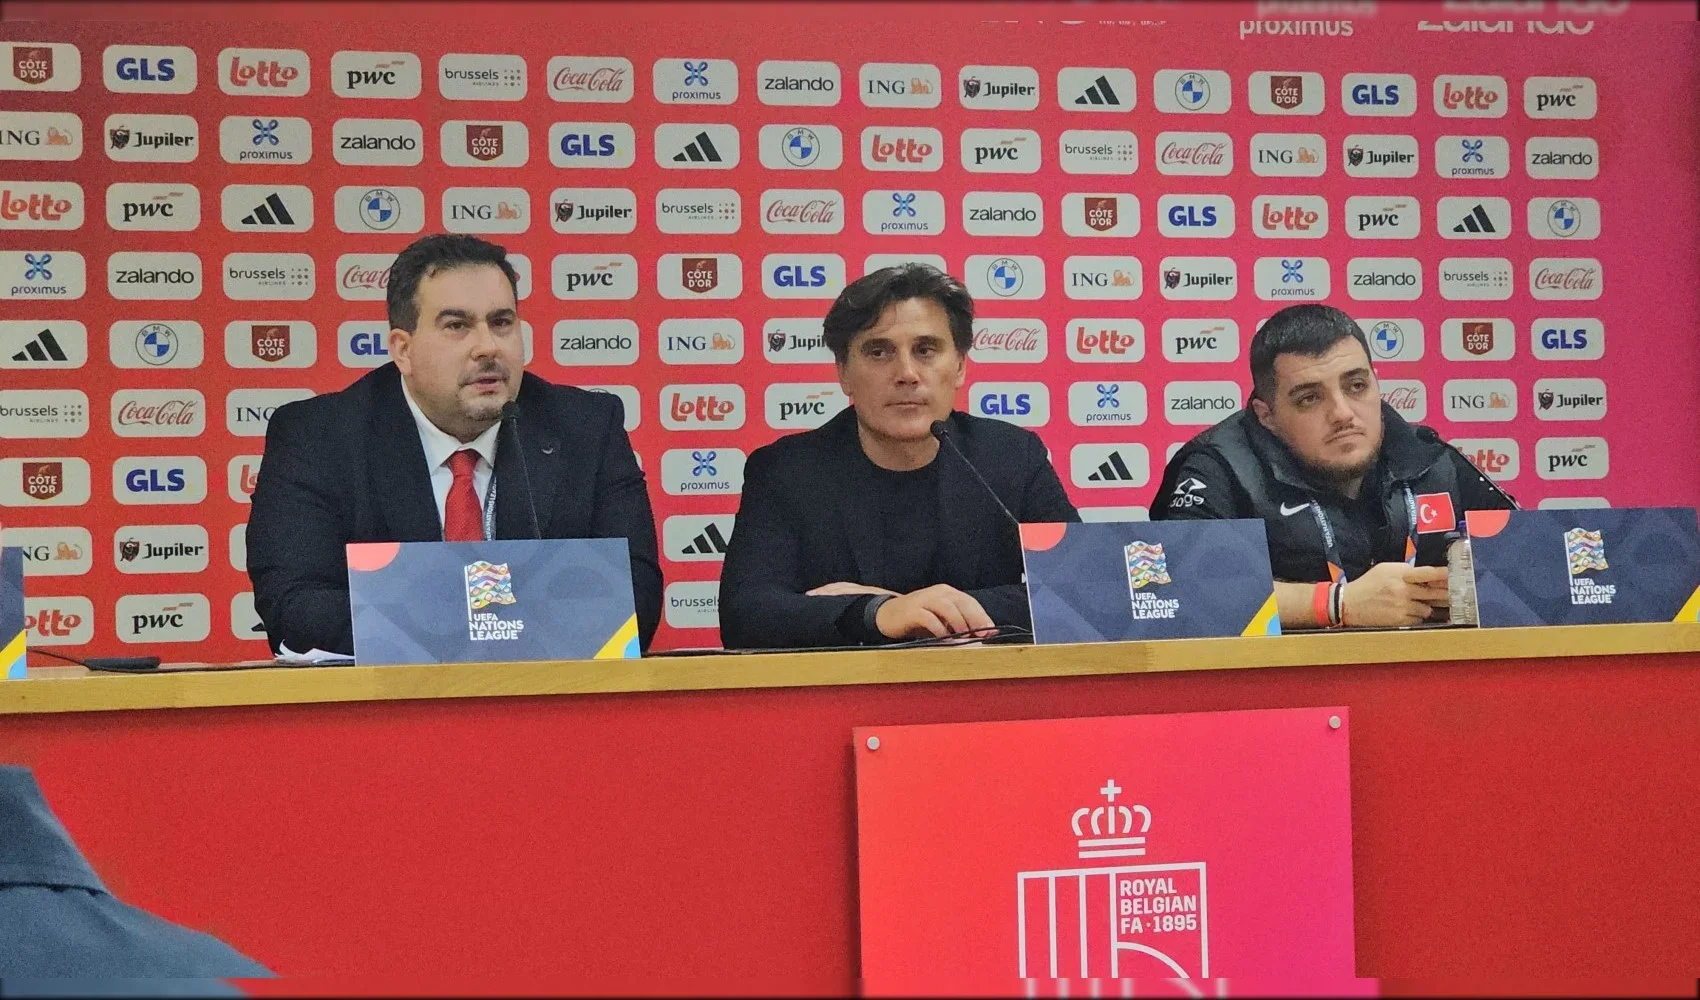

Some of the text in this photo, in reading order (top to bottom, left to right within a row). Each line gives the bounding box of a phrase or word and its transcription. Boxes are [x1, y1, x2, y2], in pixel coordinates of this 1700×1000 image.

[19, 58, 47, 71] CÔTE
[116, 58, 175, 81] GLS
[20, 69, 46, 79] D'OR
[347, 67, 396, 88] pwc
[445, 68, 499, 81] brussels
[765, 77, 834, 92] zalando
[867, 79, 906, 95] ING
[983, 82, 1035, 98] Jupiler
[1274, 86, 1299, 97] CÔTE
[672, 90, 721, 101] proximus
[1276, 95, 1298, 105] D'OR
[1352, 84, 1399, 106] GLS
[1536, 92, 1576, 111] pwc
[135, 132, 193, 148] Jupiler
[340, 135, 416, 151] zalando
[471, 135, 498, 147] CÔTE
[560, 134, 615, 157] GLS
[239, 149, 293, 161] proximus
[472, 146, 497, 156] D'OR
[975, 143, 1019, 165] pwc
[1065, 143, 1113, 156] brussels
[1258, 149, 1293, 165] ING
[1366, 150, 1414, 166] Jupiler
[1532, 152, 1592, 166] zalando
[1451, 166, 1494, 177] proximus
[123, 201, 174, 222] pwc
[451, 205, 492, 220] ING
[577, 205, 632, 221] Jupiler
[662, 202, 714, 215] brussels
[969, 207, 1036, 222] zalando
[1089, 207, 1113, 219] CÔTE
[1090, 217, 1112, 227] D'OR
[1168, 206, 1217, 227] GLS
[1358, 212, 1399, 231] pwc
[881, 220, 928, 232] proximus
[116, 269, 194, 284] zalando
[229, 267, 285, 281] brussels
[343, 265, 390, 288] Coca-C
[566, 269, 614, 291] pwc
[687, 268, 713, 280] CÔTE
[773, 265, 826, 287] GLS
[1072, 272, 1108, 288] ING
[1183, 272, 1233, 289] Jupiler
[1353, 272, 1416, 286] zalando
[1443, 271, 1489, 284] brussels
[11, 284, 66, 296] proximus
[688, 278, 712, 289] D'OR
[1271, 287, 1315, 298] proximus
[257, 335, 285, 348] CÔTE
[350, 333, 388, 355] GL
[560, 335, 632, 350] zalando
[667, 336, 706, 351] ING
[788, 335, 825, 351] Jupil
[1175, 335, 1218, 354] pwc
[1466, 331, 1489, 343] CÔTE
[1541, 329, 1588, 350] GLS
[258, 347, 284, 356] D'OR
[1468, 341, 1488, 350] D'OR
[980, 393, 1031, 415] GLS
[1171, 396, 1235, 411] zalando
[1451, 395, 1484, 409] ING
[1557, 393, 1602, 409] Jupiler
[0, 405, 58, 416] brussels
[779, 399, 825, 420] pwc
[1086, 412, 1131, 423] proximus
[1548, 451, 1588, 471] pwc
[28, 473, 57, 485] CÔTE
[126, 469, 185, 492] GLS
[680, 479, 730, 491] proximus
[30, 484, 56, 494] D'OR
[1325, 531, 1333, 547] UEFA
[23, 546, 50, 561] NG
[142, 542, 203, 560] Jupiler
[1574, 578, 1595, 586] UEFA
[1135, 593, 1157, 601] UEFA
[1570, 585, 1616, 595] NATIONS
[671, 596, 716, 607] brussel
[1131, 599, 1180, 610] NATIONS
[1571, 593, 1612, 604] LEAGUE
[473, 613, 498, 621] UEFA
[1132, 608, 1176, 619] LEAGUE
[25, 610, 82, 636] otto
[132, 611, 184, 633] pwc
[469, 620, 524, 631] NATIONS
[470, 629, 519, 640] LEAGUE
[1120, 878, 1177, 896] ROYAL
[1120, 895, 1197, 916] BELGIAN
